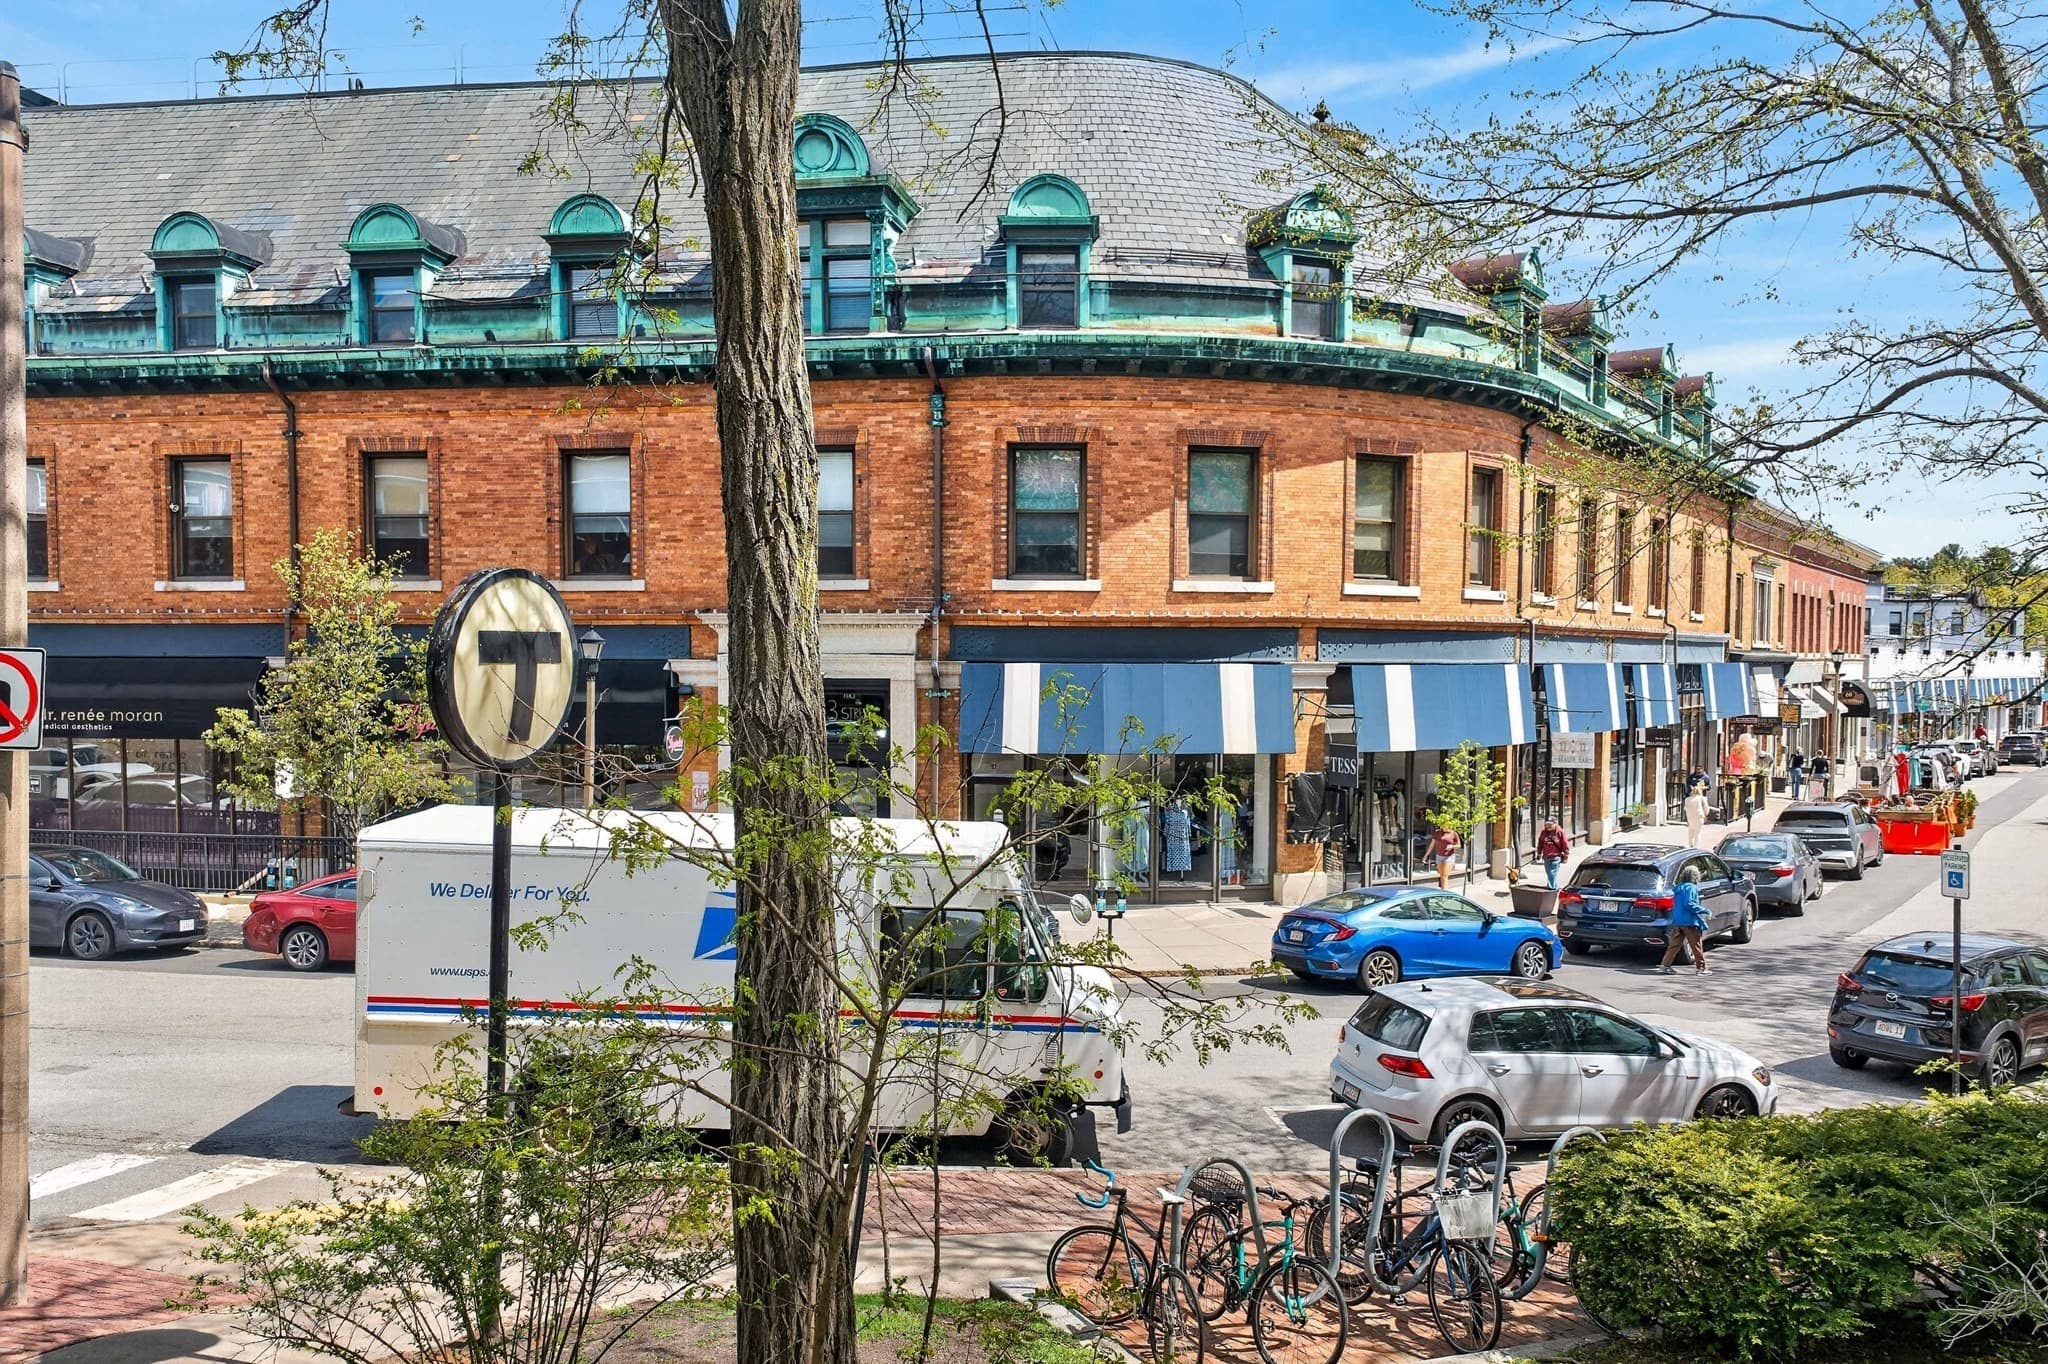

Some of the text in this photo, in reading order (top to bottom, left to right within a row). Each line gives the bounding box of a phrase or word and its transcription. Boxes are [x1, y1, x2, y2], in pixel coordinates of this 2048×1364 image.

[478, 631, 561, 741] T
[61, 708, 105, 721] renée
[110, 711, 163, 722] moran
[43, 722, 113, 731] edical aesthetics
[644, 754, 657, 763] 95
[1330, 756, 1357, 775] TESS
[1373, 862, 1405, 880] TESS
[1944, 862, 1967, 871] PARKING
[430, 882, 456, 897] We
[524, 885, 554, 901] For
[556, 886, 591, 902] You.
